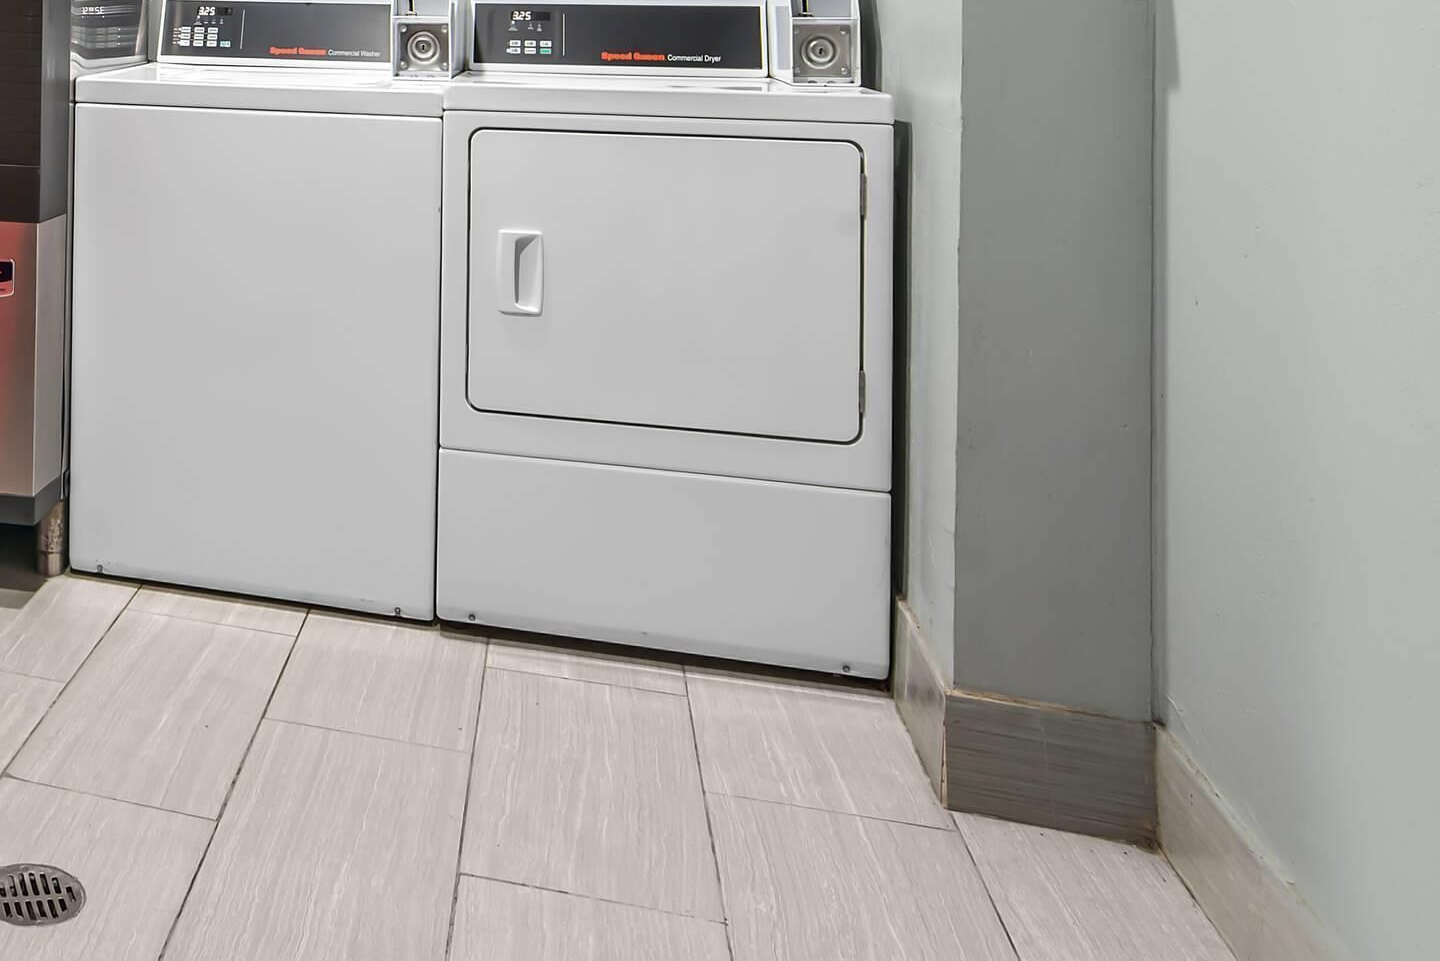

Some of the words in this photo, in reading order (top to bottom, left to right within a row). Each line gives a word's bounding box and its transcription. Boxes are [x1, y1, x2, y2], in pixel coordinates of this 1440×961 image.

[601, 52, 632, 61] Speed
[667, 54, 703, 62] Commercial
[704, 55, 721, 64] Dryer
